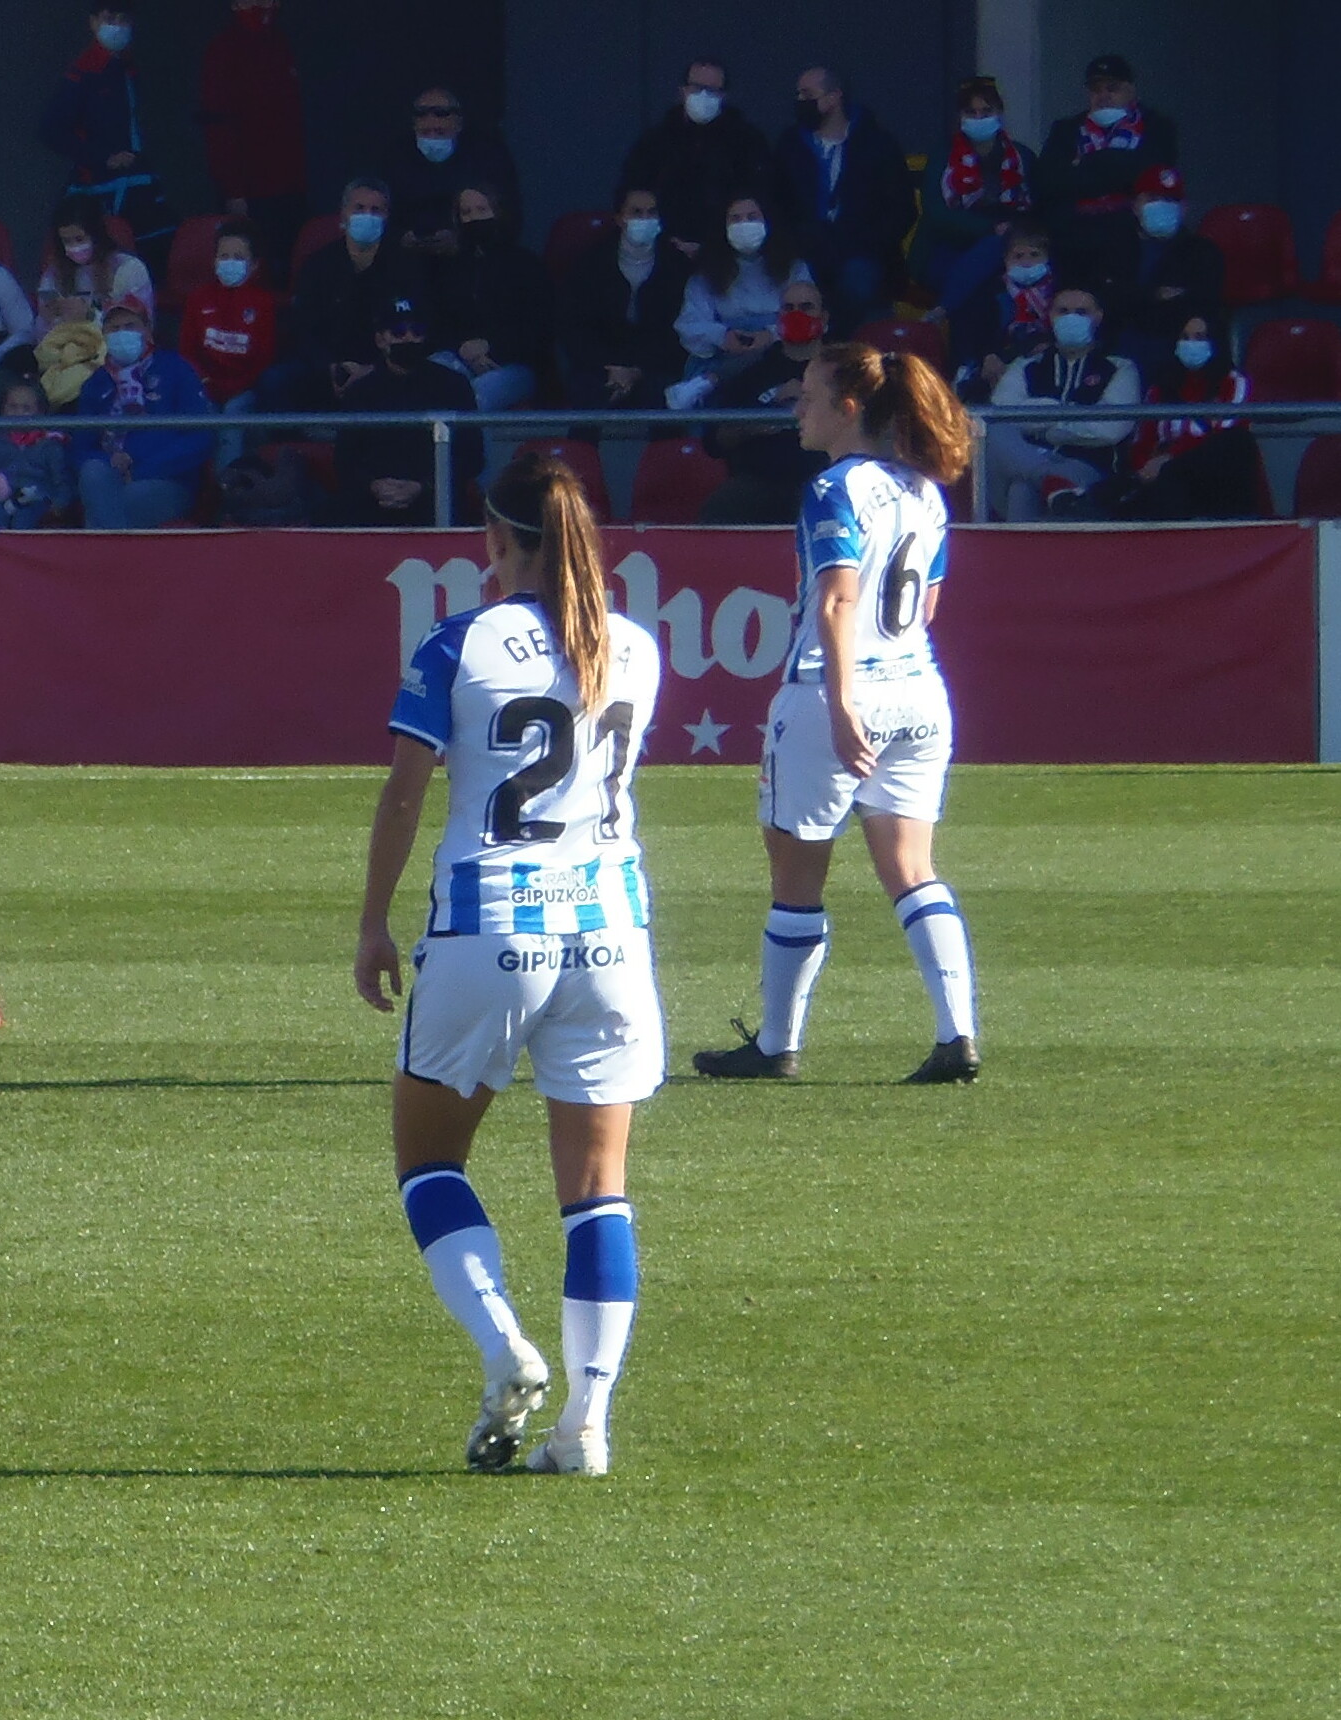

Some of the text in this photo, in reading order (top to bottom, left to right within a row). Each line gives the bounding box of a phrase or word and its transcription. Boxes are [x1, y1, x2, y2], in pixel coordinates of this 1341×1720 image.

[876, 531, 921, 642] 6
[482, 696, 634, 848] 21
[511, 888, 600, 904] GIPUZKOA
[497, 945, 626, 973] GIPUZKOA
